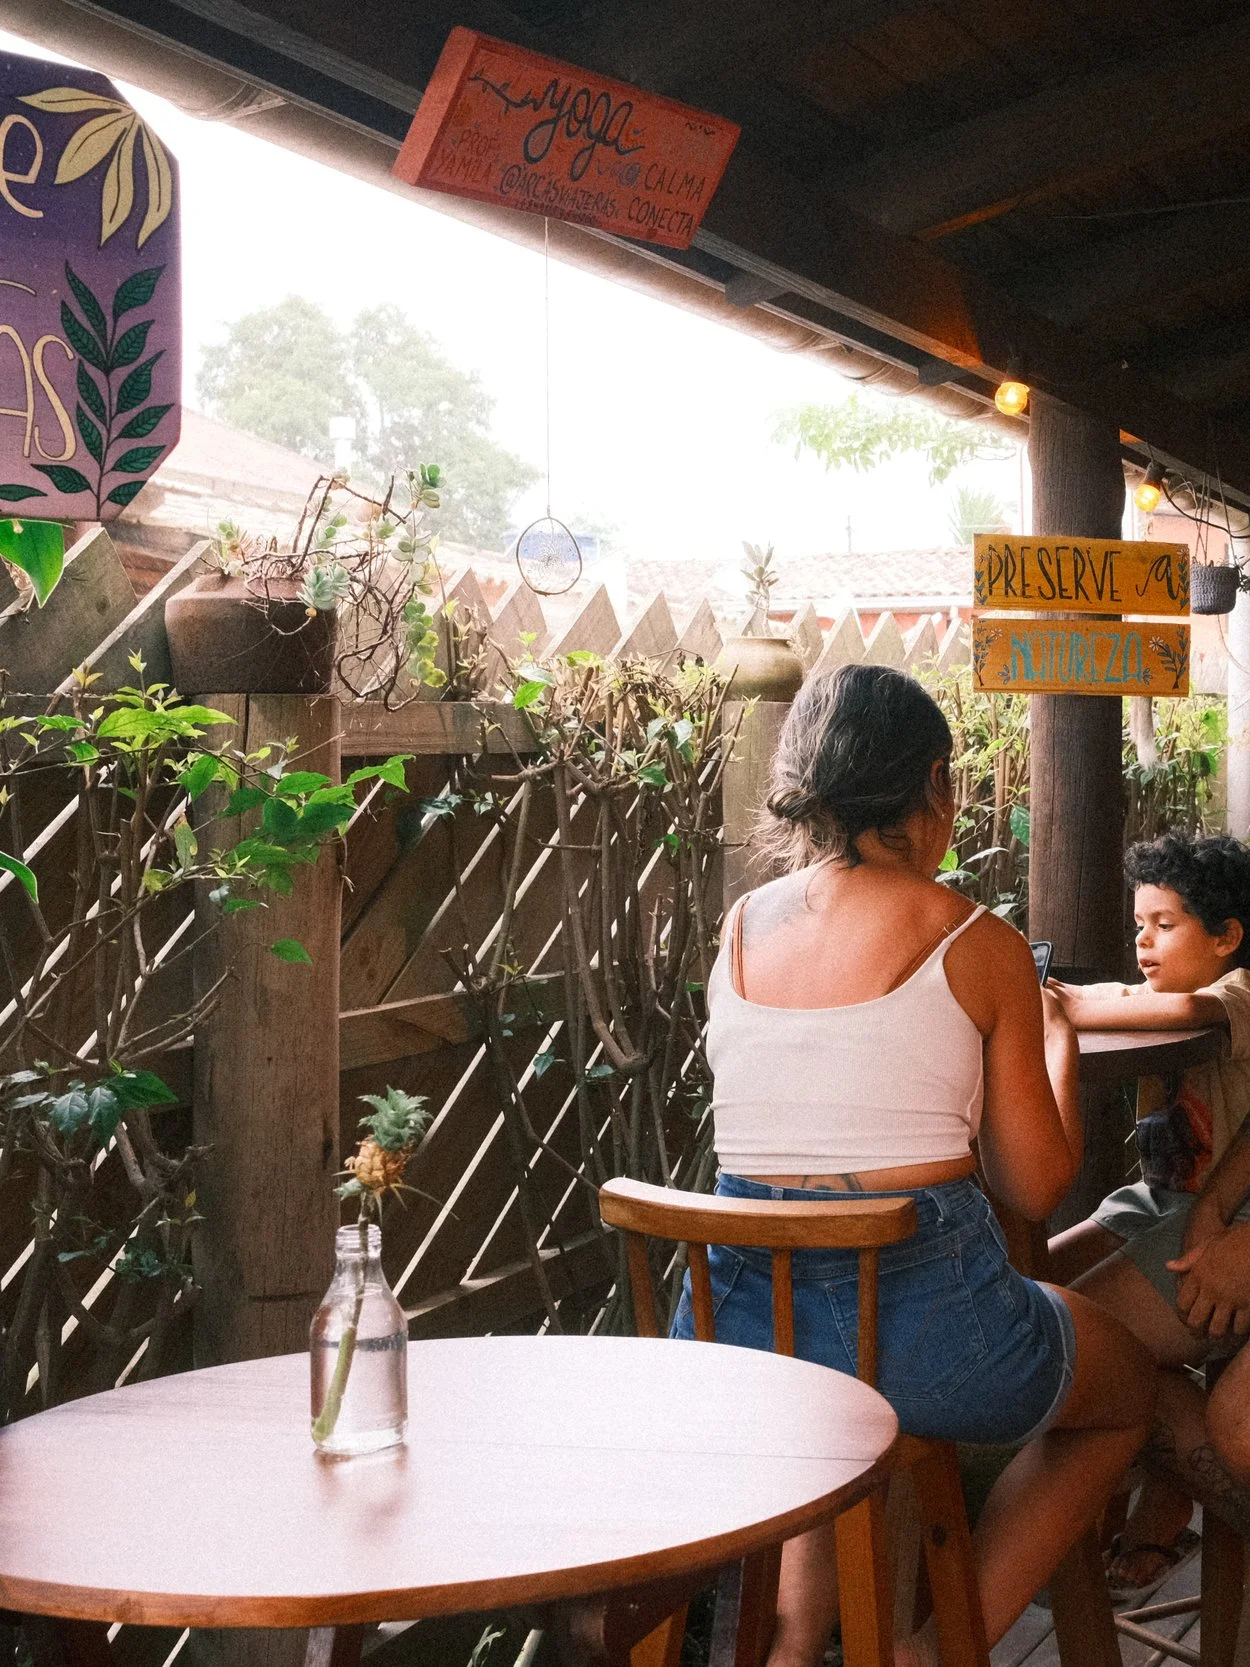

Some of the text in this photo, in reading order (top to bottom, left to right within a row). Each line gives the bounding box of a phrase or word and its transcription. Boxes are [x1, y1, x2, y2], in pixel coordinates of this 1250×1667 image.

[525, 77, 646, 182] yoga
[644, 163, 706, 202] CALMA
[627, 197, 694, 237] CONECTA
[987, 543, 1123, 604] PRESERVE
[1010, 631, 1144, 684] NATUREZA
